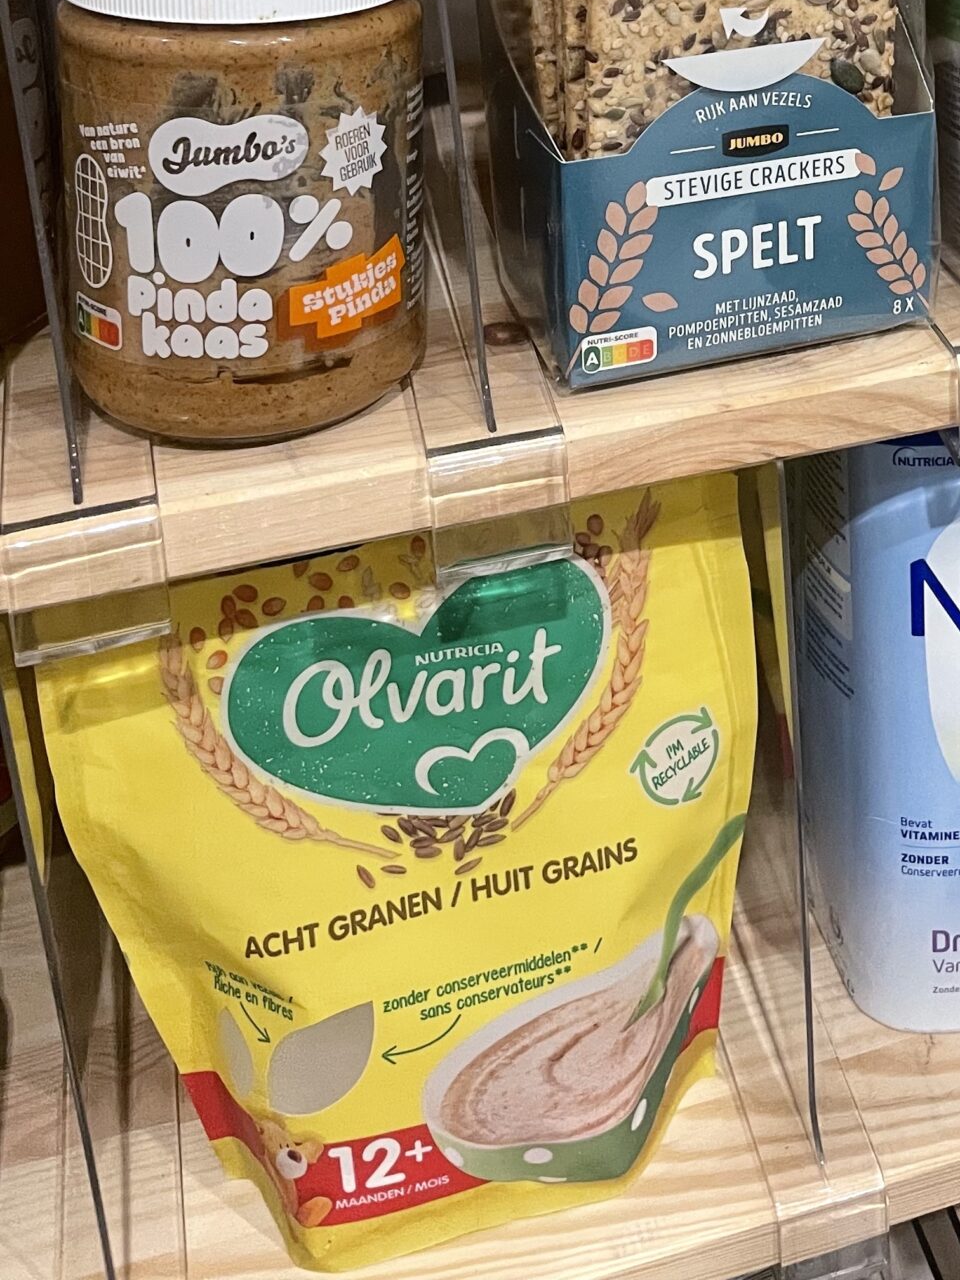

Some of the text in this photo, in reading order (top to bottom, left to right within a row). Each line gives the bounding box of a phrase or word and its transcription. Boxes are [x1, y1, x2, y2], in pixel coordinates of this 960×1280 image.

[694, 90, 814, 124] RIJK AAN VEZELS
[109, 136, 141, 150] bron
[334, 122, 371, 151] ROEREN
[344, 142, 370, 161] VOOR
[728, 131, 786, 152] JUMBO
[162, 131, 297, 175] Jumbo's
[339, 153, 378, 182] GEBRUIK
[663, 154, 847, 201] STEVIGE CRACKERS
[114, 191, 353, 284] 100%
[692, 214, 823, 280] SPELT
[127, 271, 274, 324] Pinda
[302, 251, 398, 315] Stukjes
[327, 276, 397, 327] Pinda
[714, 288, 800, 316] MET LIJNZAAD,
[892, 299, 905, 315] 8
[667, 295, 844, 340] POMPOENPITTEN, SESAMZAAD
[686, 313, 823, 351] EN ZONNEBLOEMPITTEN
[142, 311, 269, 359] kaas
[586, 331, 640, 346] NUTRI-SCORE
[584, 351, 600, 368] A
[898, 456, 954, 467] NUTRICIA
[415, 642, 504, 665] NUTRICIA
[282, 628, 562, 748] Olvarit
[651, 737, 710, 790] RECYCLABLE
[665, 739, 684, 760] I'M
[900, 816, 932, 829] Bevat
[901, 829, 960, 841] VITAMINE
[901, 853, 949, 865] ZONDER
[244, 923, 320, 959] ACHT
[327, 887, 443, 942] GRANEN
[471, 866, 534, 903] HUIT
[541, 838, 638, 884] GRAINS
[214, 975, 293, 1022] Riche en fibres
[383, 988, 431, 1013] zonder
[420, 1002, 452, 1021] sans
[327, 1137, 433, 1193] 12+
[335, 1187, 405, 1210] MAANDEN
[414, 1175, 450, 1192] MOIS
